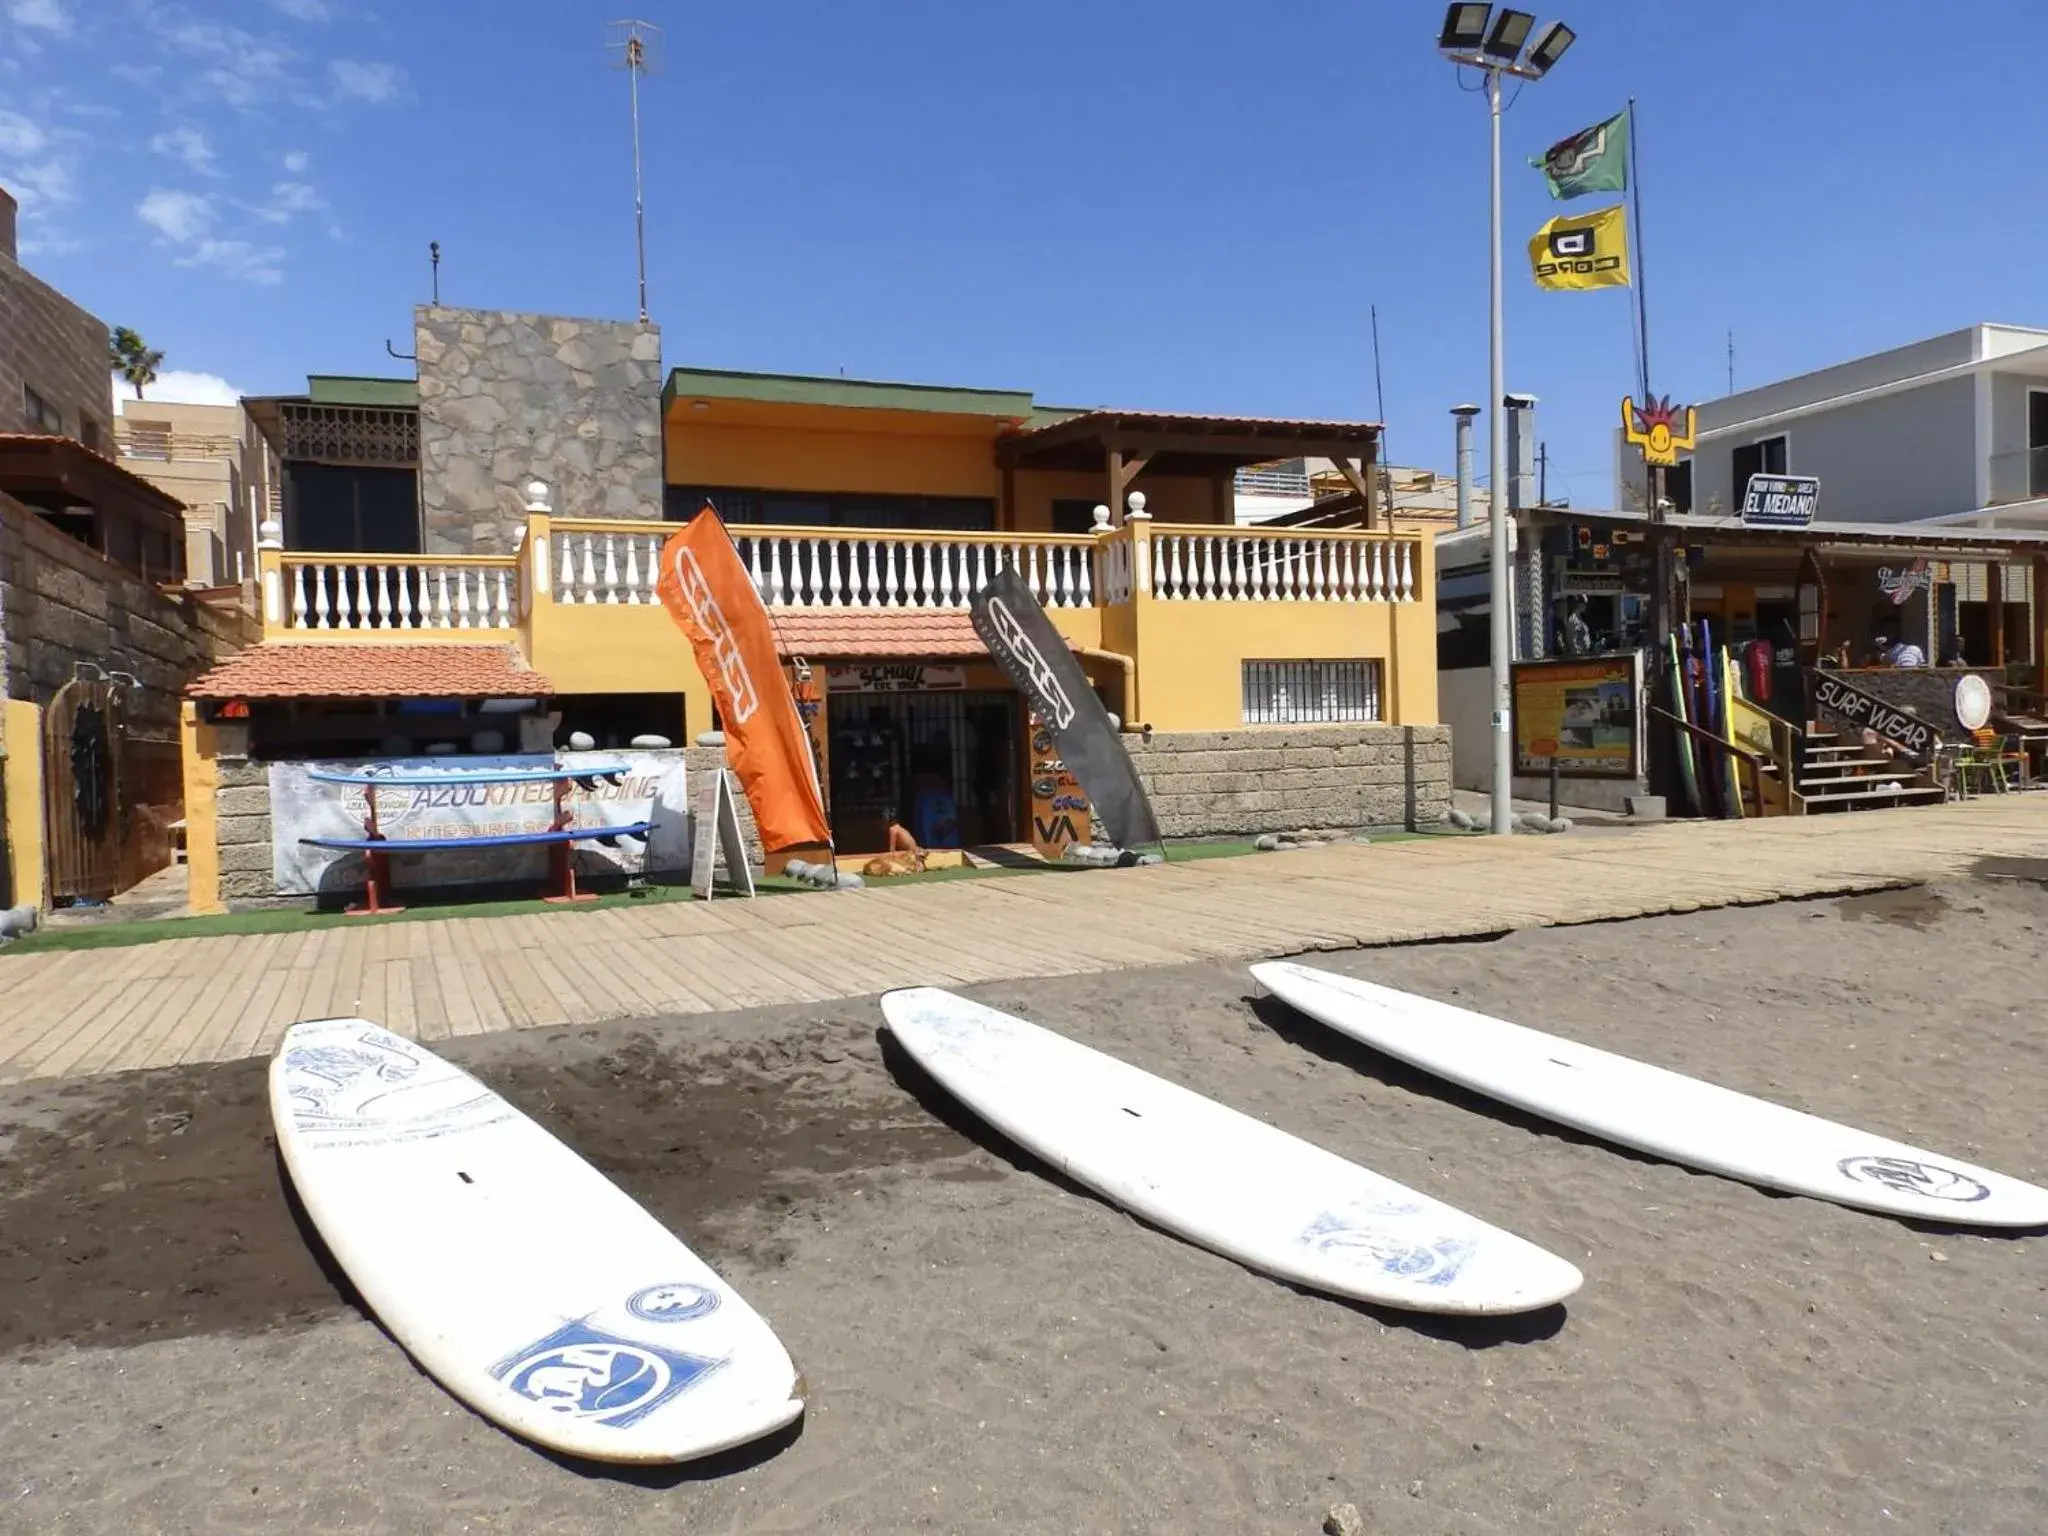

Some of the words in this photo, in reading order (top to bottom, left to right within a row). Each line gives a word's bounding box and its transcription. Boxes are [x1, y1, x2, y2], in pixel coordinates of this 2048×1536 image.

[1746, 492, 1761, 513] EL
[1815, 682, 1871, 717] SURF
[1868, 704, 1928, 749] WEAR
